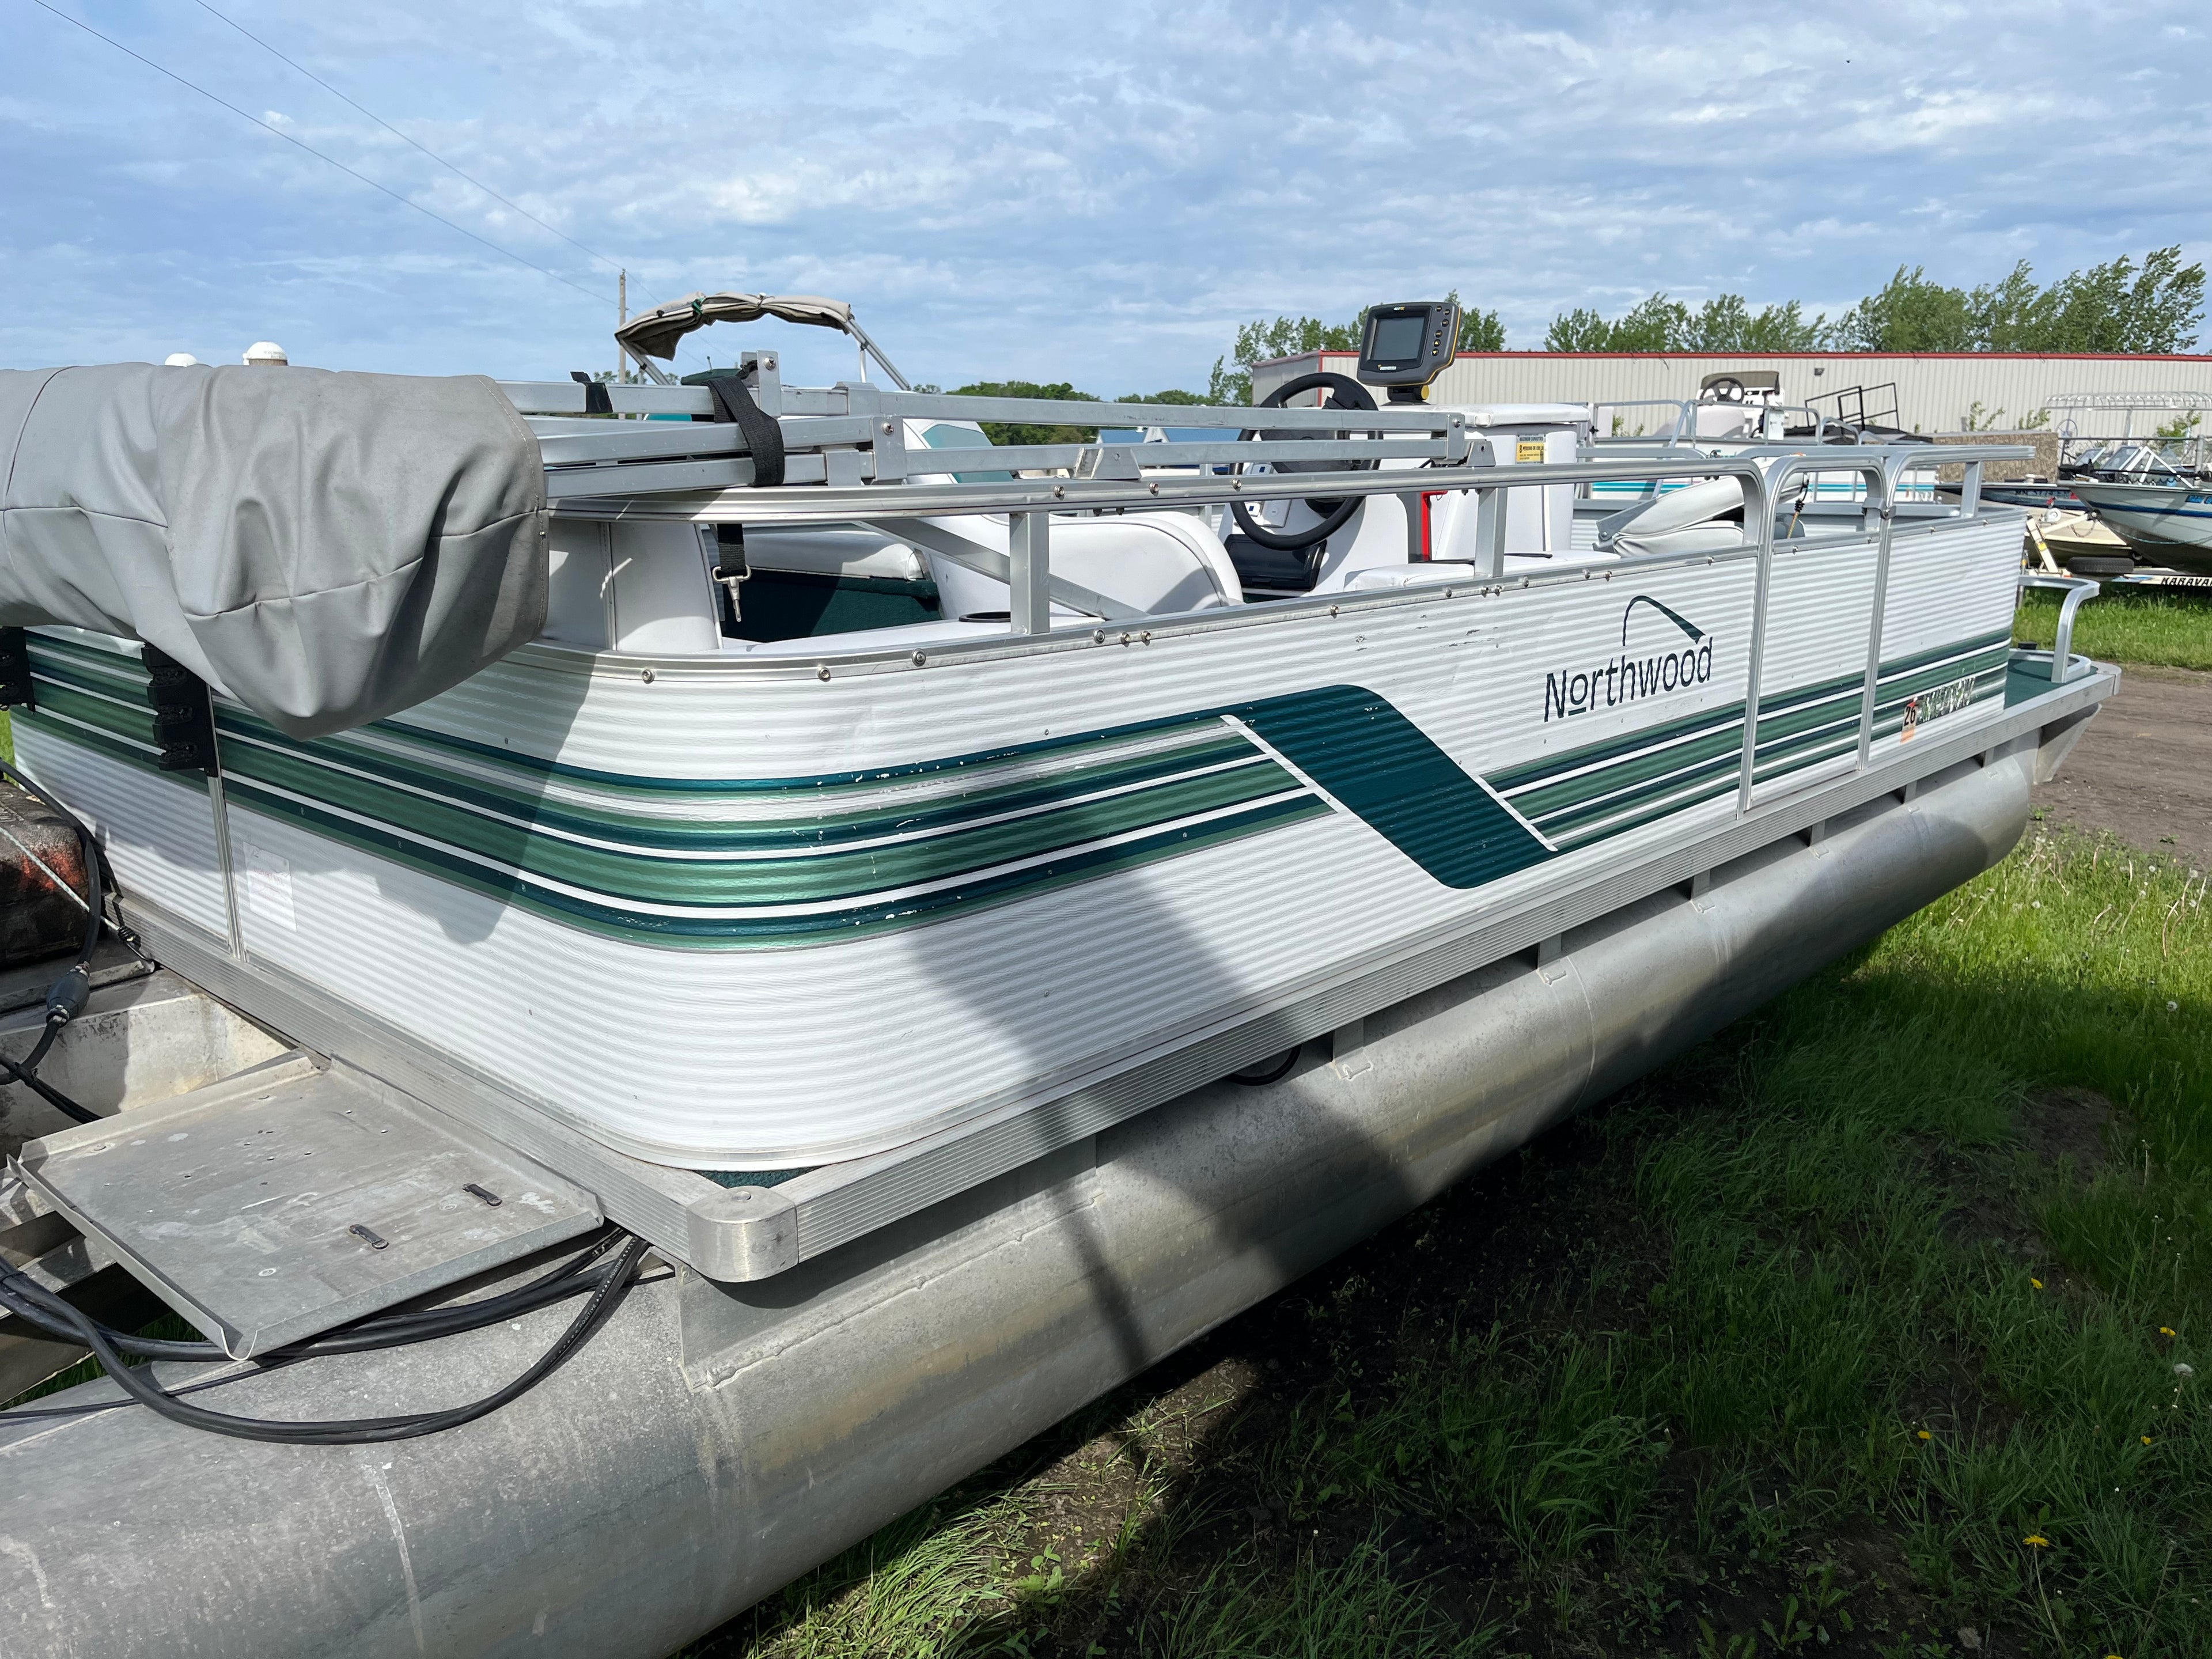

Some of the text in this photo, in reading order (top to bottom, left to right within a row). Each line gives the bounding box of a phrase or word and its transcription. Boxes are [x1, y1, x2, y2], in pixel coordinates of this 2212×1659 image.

[1544, 636, 1713, 723] Northwood
[1903, 706, 1916, 726] 26
[609, 1258, 624, 1279] POSITIVE
